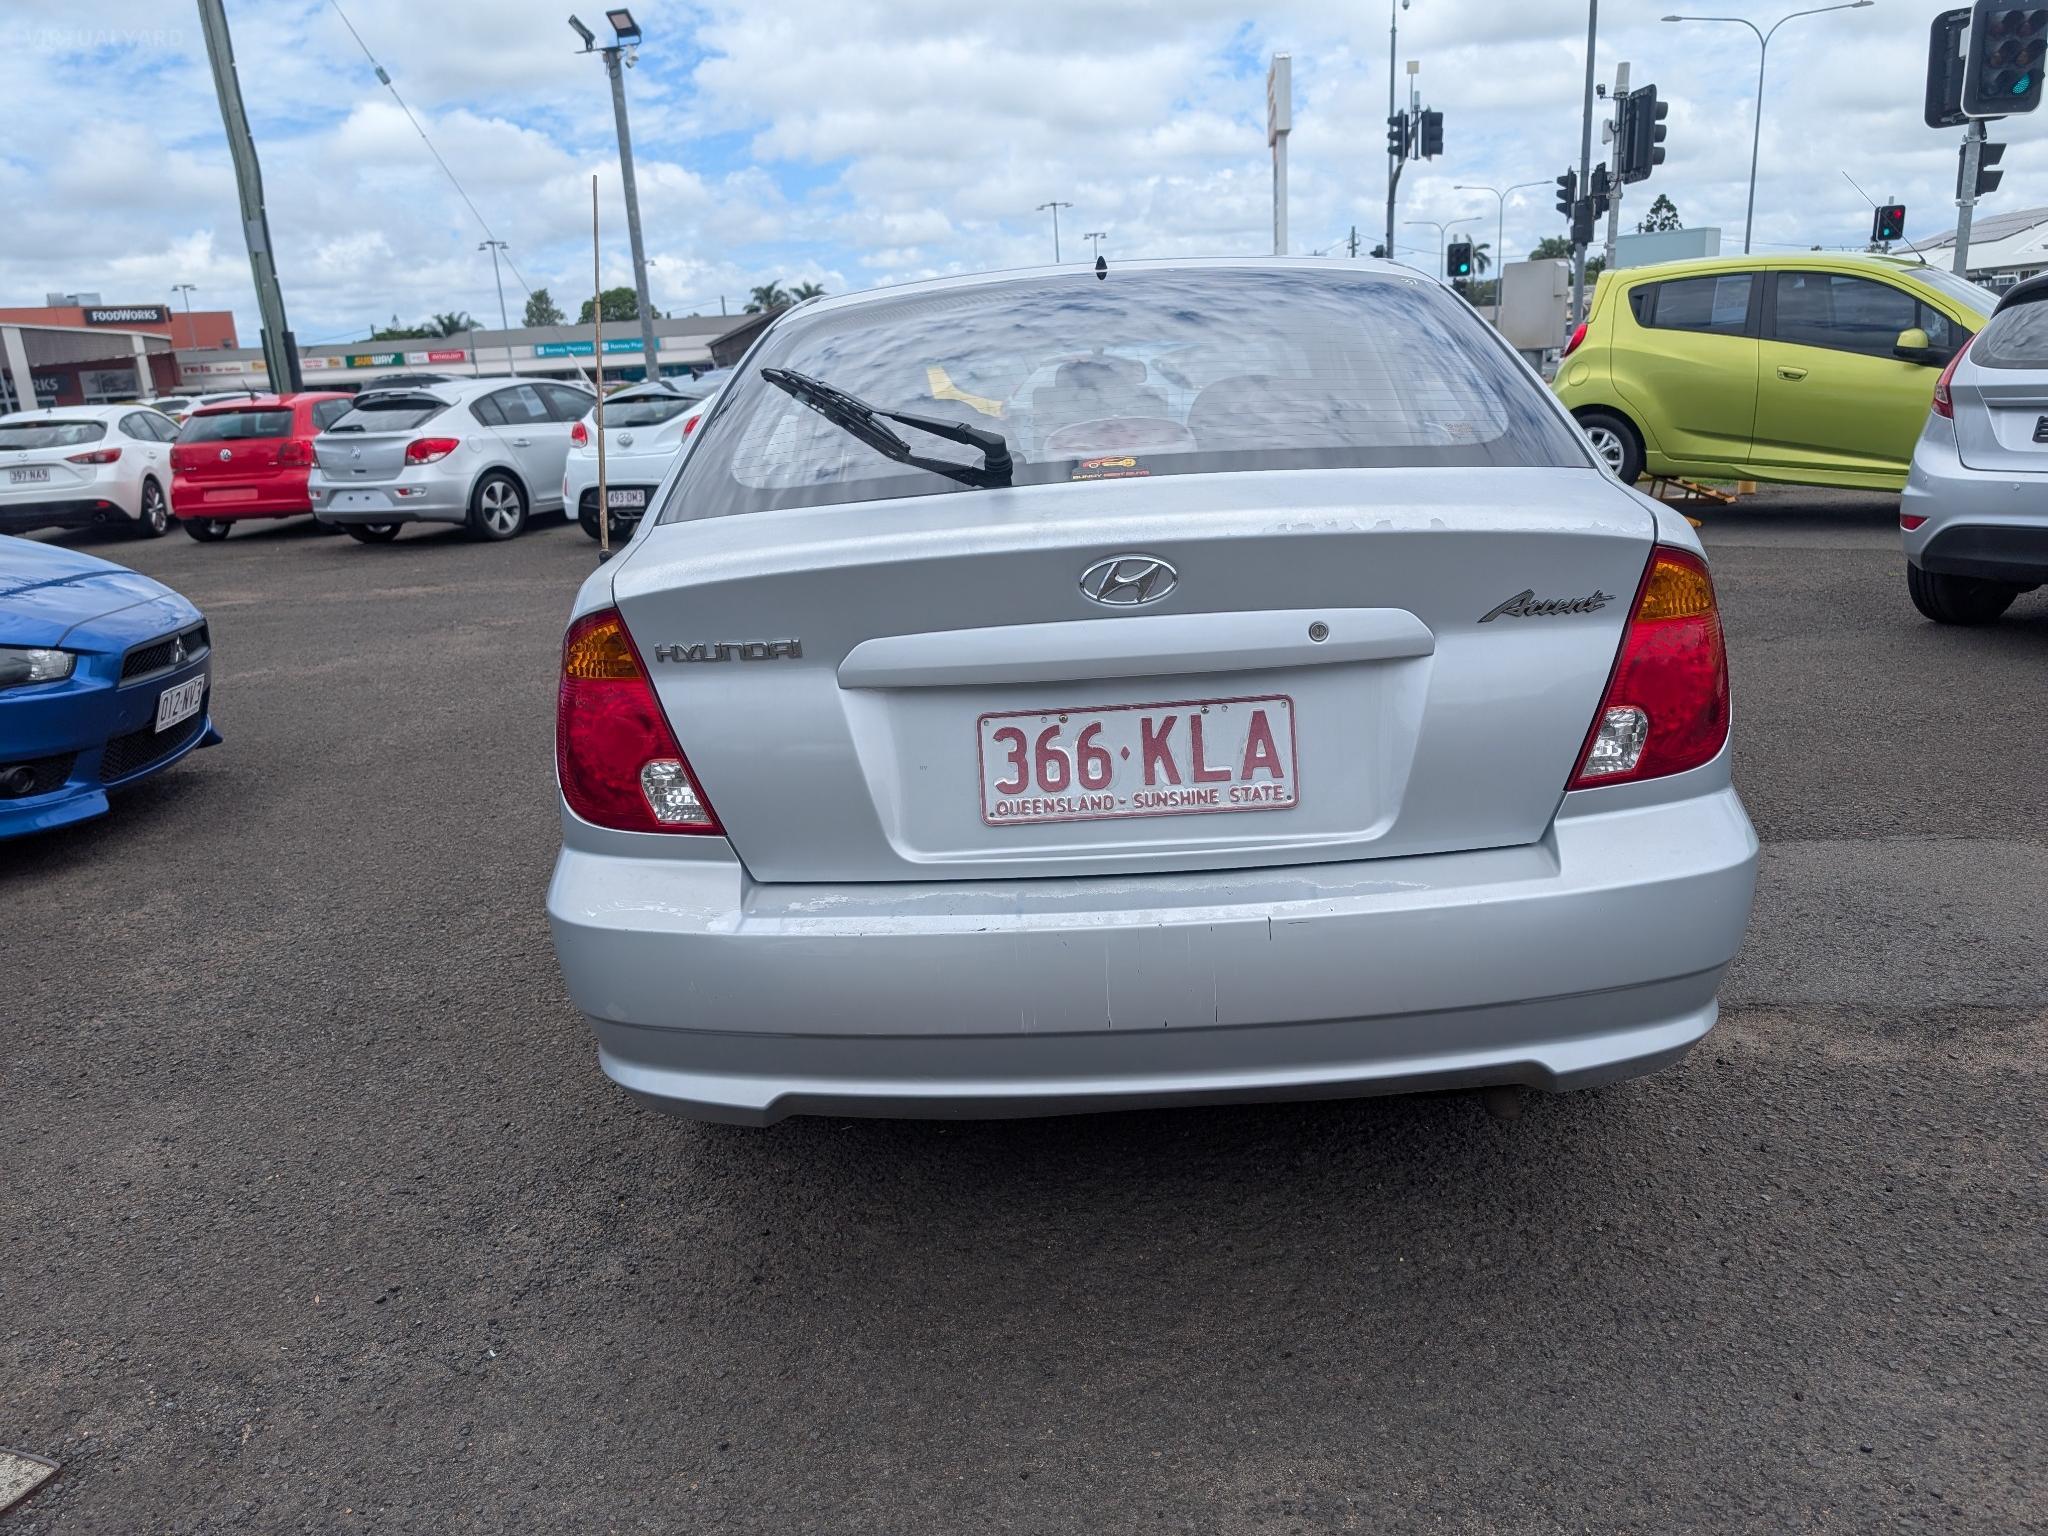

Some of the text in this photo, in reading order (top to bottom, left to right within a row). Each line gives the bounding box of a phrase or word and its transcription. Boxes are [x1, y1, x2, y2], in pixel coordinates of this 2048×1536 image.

[92, 309, 158, 322] FOODWORKS
[354, 353, 396, 366] SUBWAY
[1477, 588, 1616, 624] Accent
[654, 638, 803, 663] HYUNDAI
[995, 796, 1115, 817] QUEENSLAND
[1133, 788, 1220, 809] SUNSHINE
[1229, 784, 1284, 804] STATE
